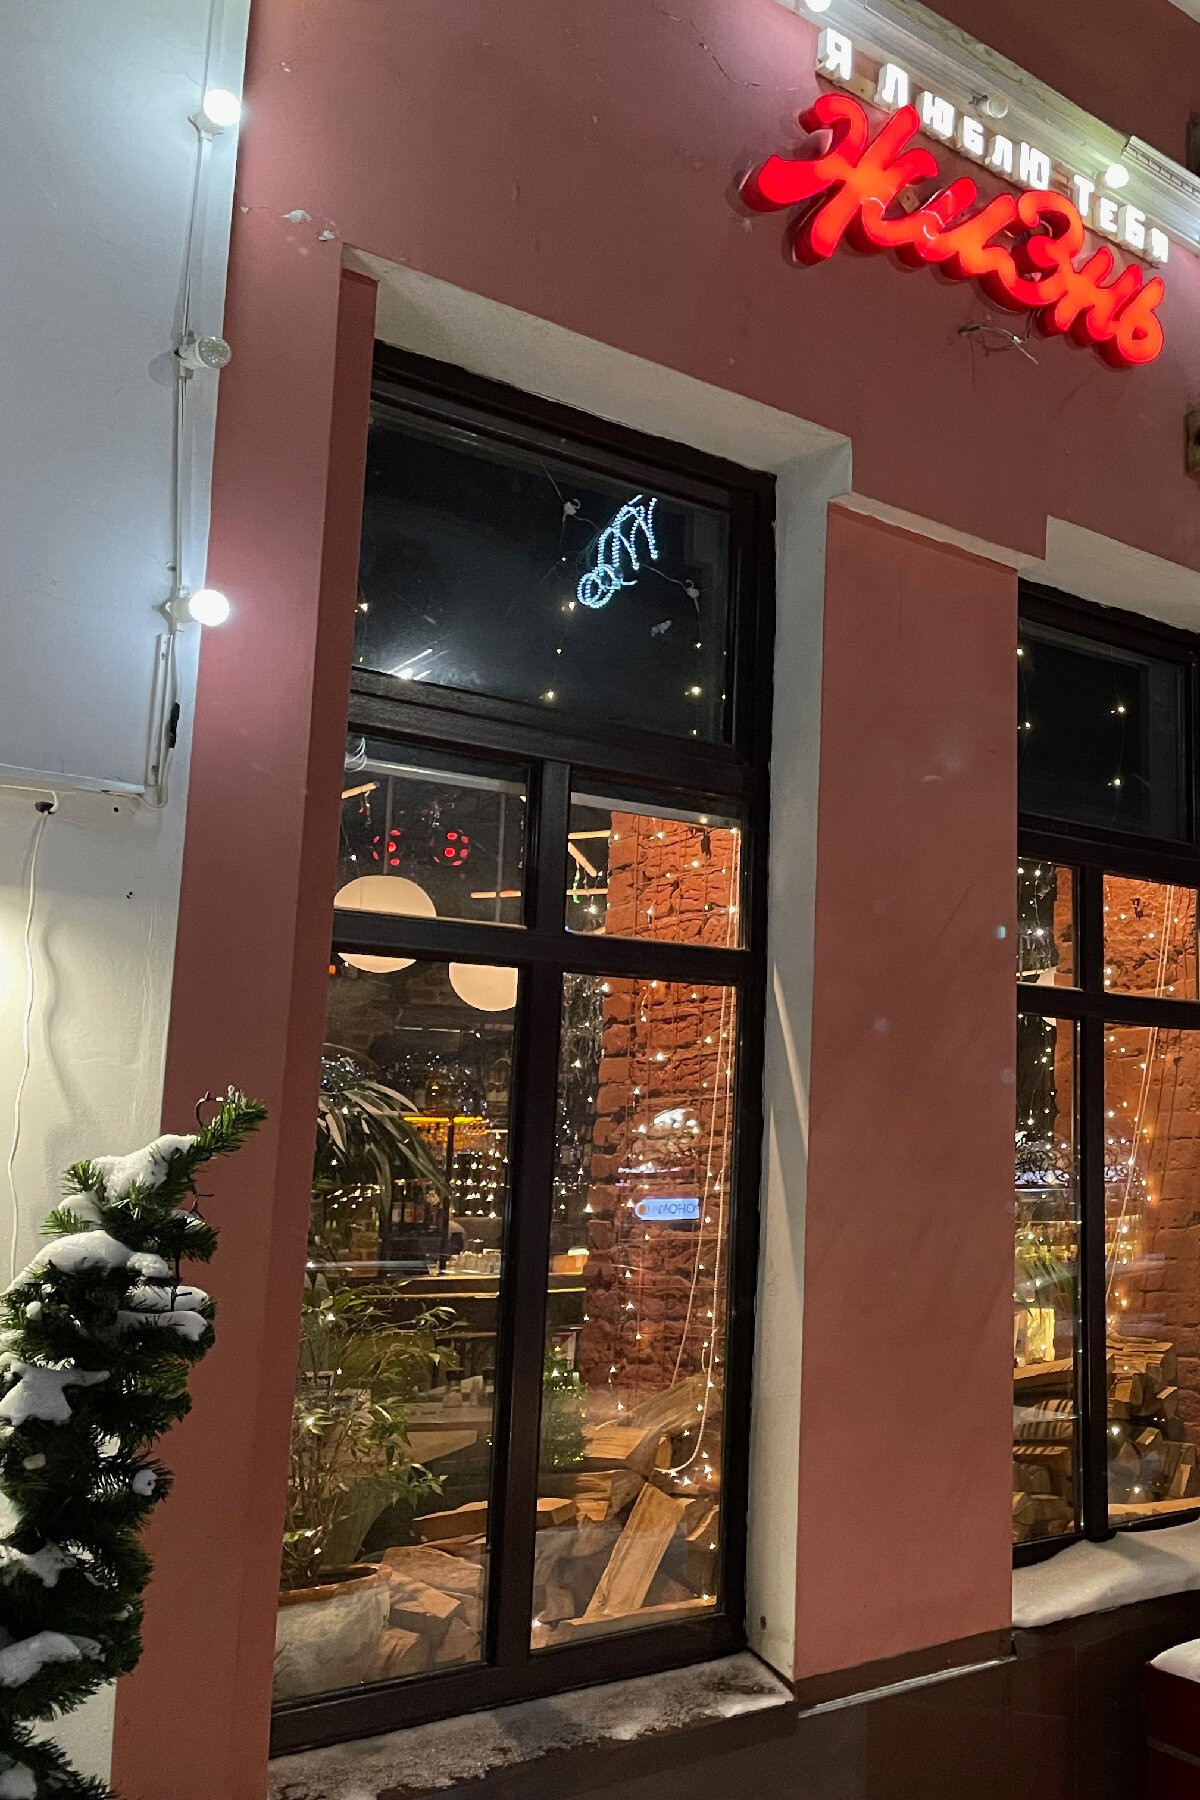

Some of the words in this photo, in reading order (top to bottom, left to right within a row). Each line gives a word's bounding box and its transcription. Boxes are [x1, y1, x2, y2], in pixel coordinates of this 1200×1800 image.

[818, 27, 853, 81] Я
[874, 62, 1051, 190] ЛЮБЛЮ
[1069, 173, 1169, 264] ТЕБЯ
